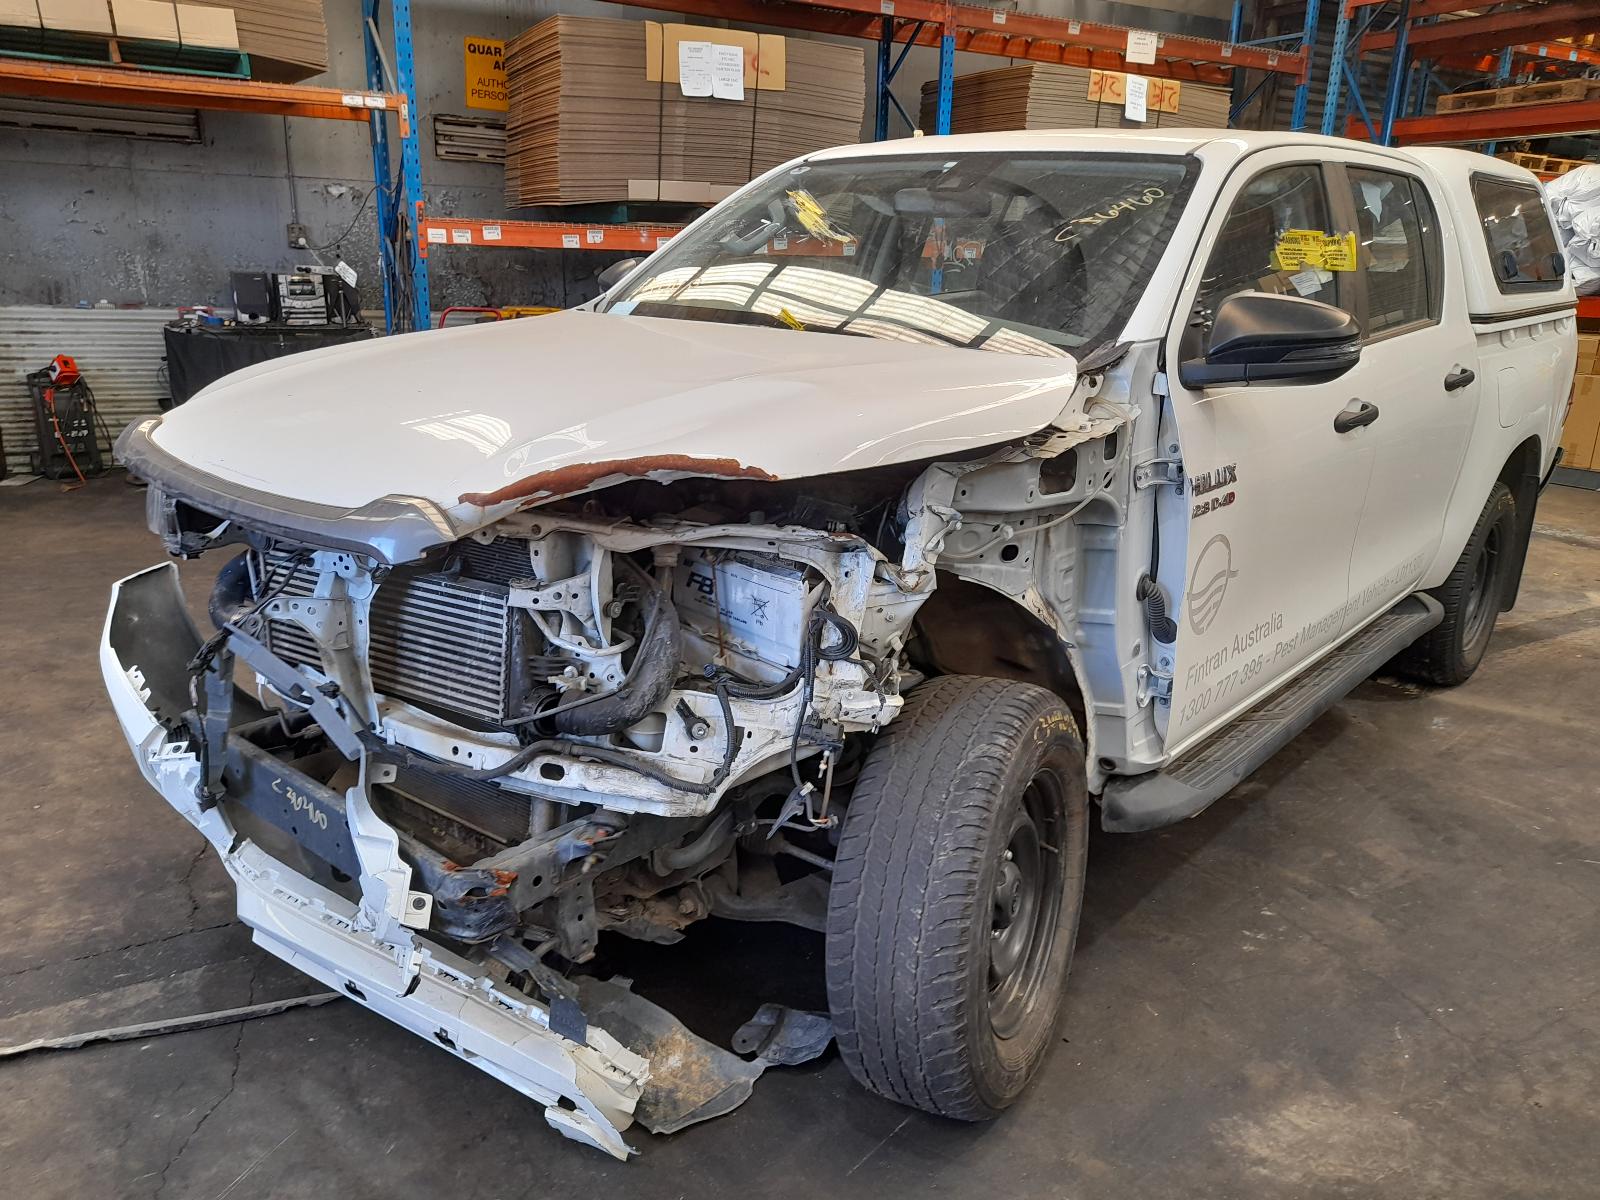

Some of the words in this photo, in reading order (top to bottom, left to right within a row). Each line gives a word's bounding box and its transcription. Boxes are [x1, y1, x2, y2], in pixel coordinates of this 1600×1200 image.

[468, 43, 505, 57] QUAR
[1190, 464, 1237, 497] HILUX
[1180, 688, 1212, 727] 1300
[1214, 669, 1239, 703] 777
[1240, 653, 1264, 685] 395
[1273, 631, 1300, 665] Pest
[1300, 592, 1361, 648] Management
[1185, 646, 1228, 691] Fintran
[1231, 611, 1283, 660] Australia
